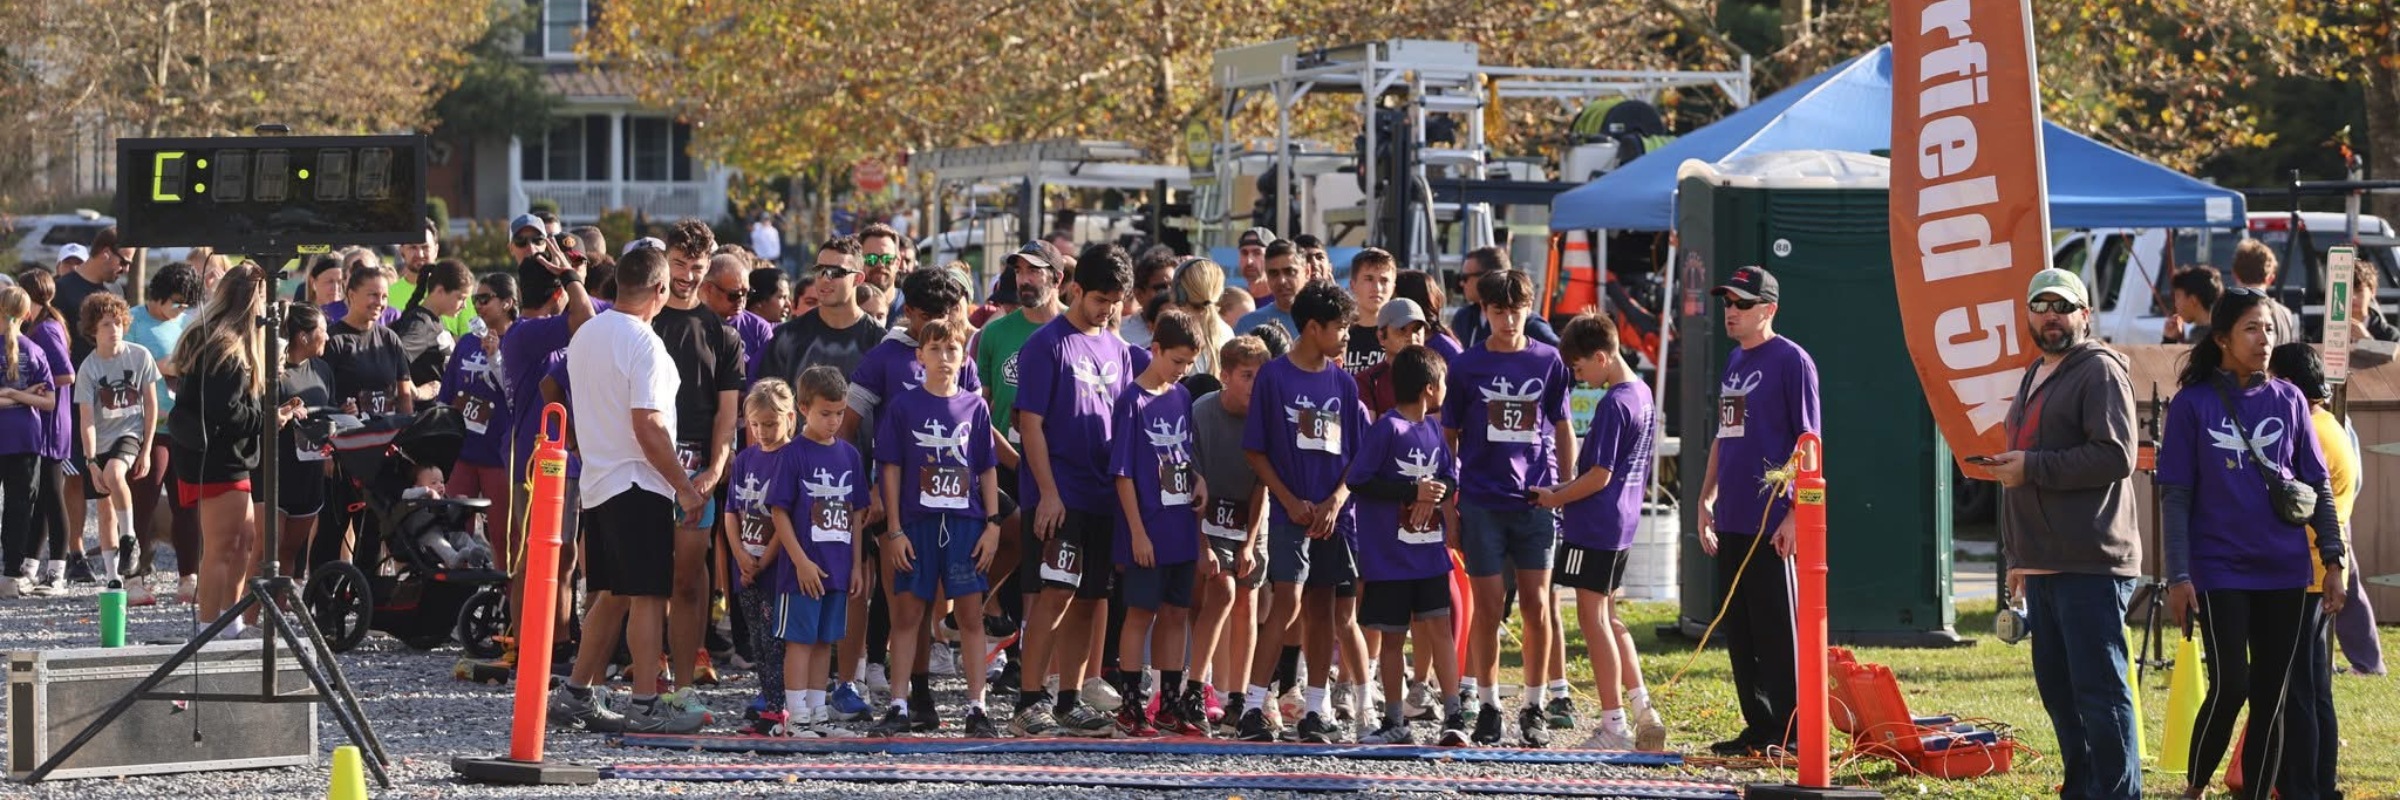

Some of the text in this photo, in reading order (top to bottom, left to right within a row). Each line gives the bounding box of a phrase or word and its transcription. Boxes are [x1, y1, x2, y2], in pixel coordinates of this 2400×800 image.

[1343, 351, 1387, 366] LL-CV
[1934, 299, 2026, 436] 5K
[113, 393, 129, 407] 44
[371, 396, 386, 413] 37
[462, 401, 481, 420] 86
[1313, 417, 1331, 438] 83
[1503, 409, 1523, 430] 52
[931, 475, 961, 495] 346
[822, 508, 849, 529] 345
[1216, 505, 1235, 527] 84
[1057, 549, 1077, 570] 87
